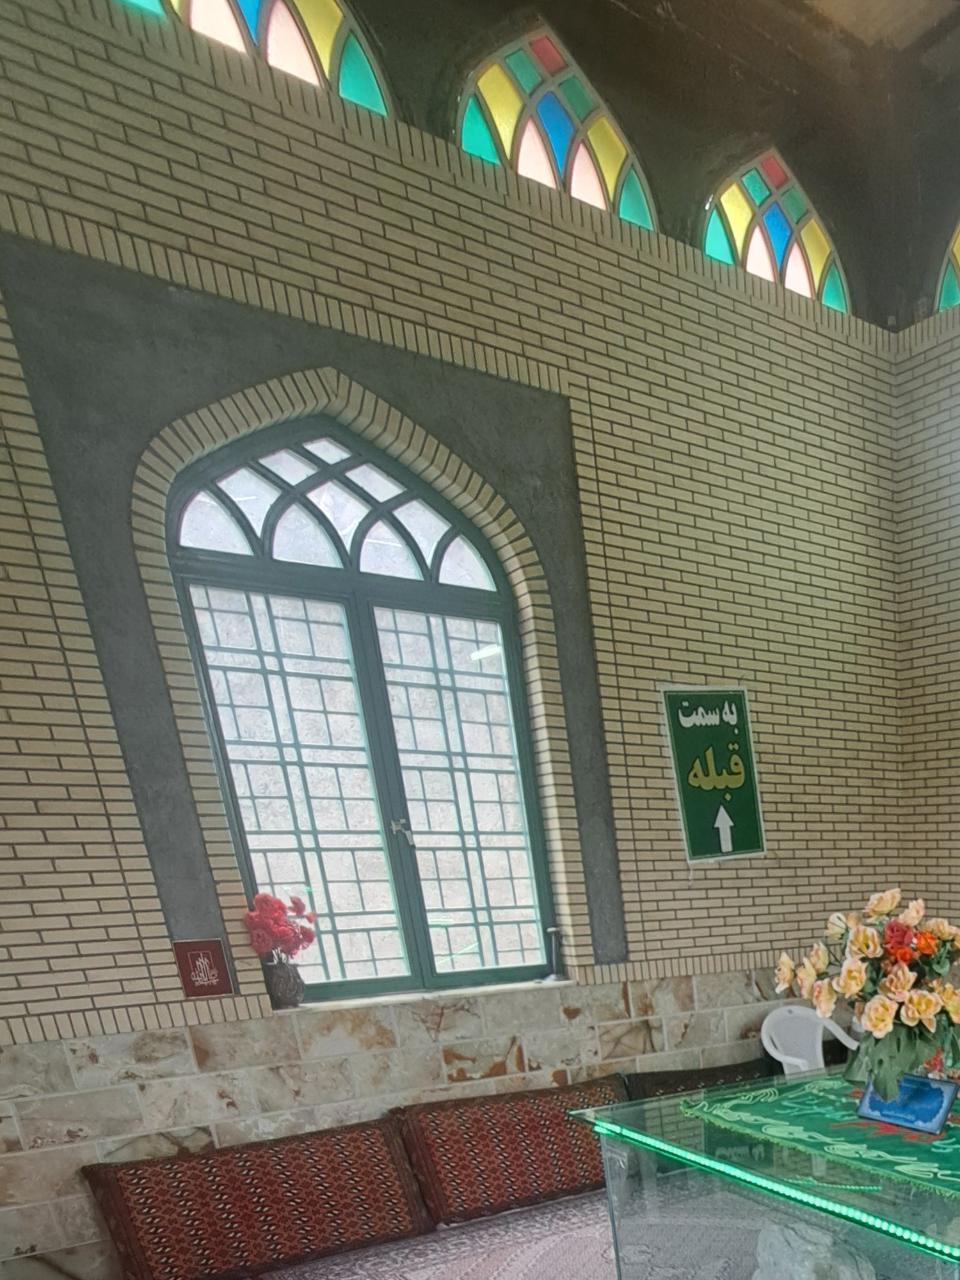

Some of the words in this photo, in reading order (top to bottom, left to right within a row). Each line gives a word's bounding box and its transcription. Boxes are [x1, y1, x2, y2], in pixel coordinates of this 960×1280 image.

[678, 701, 720, 728] سمت
[722, 700, 739, 734] به
[687, 743, 746, 802] قبله
